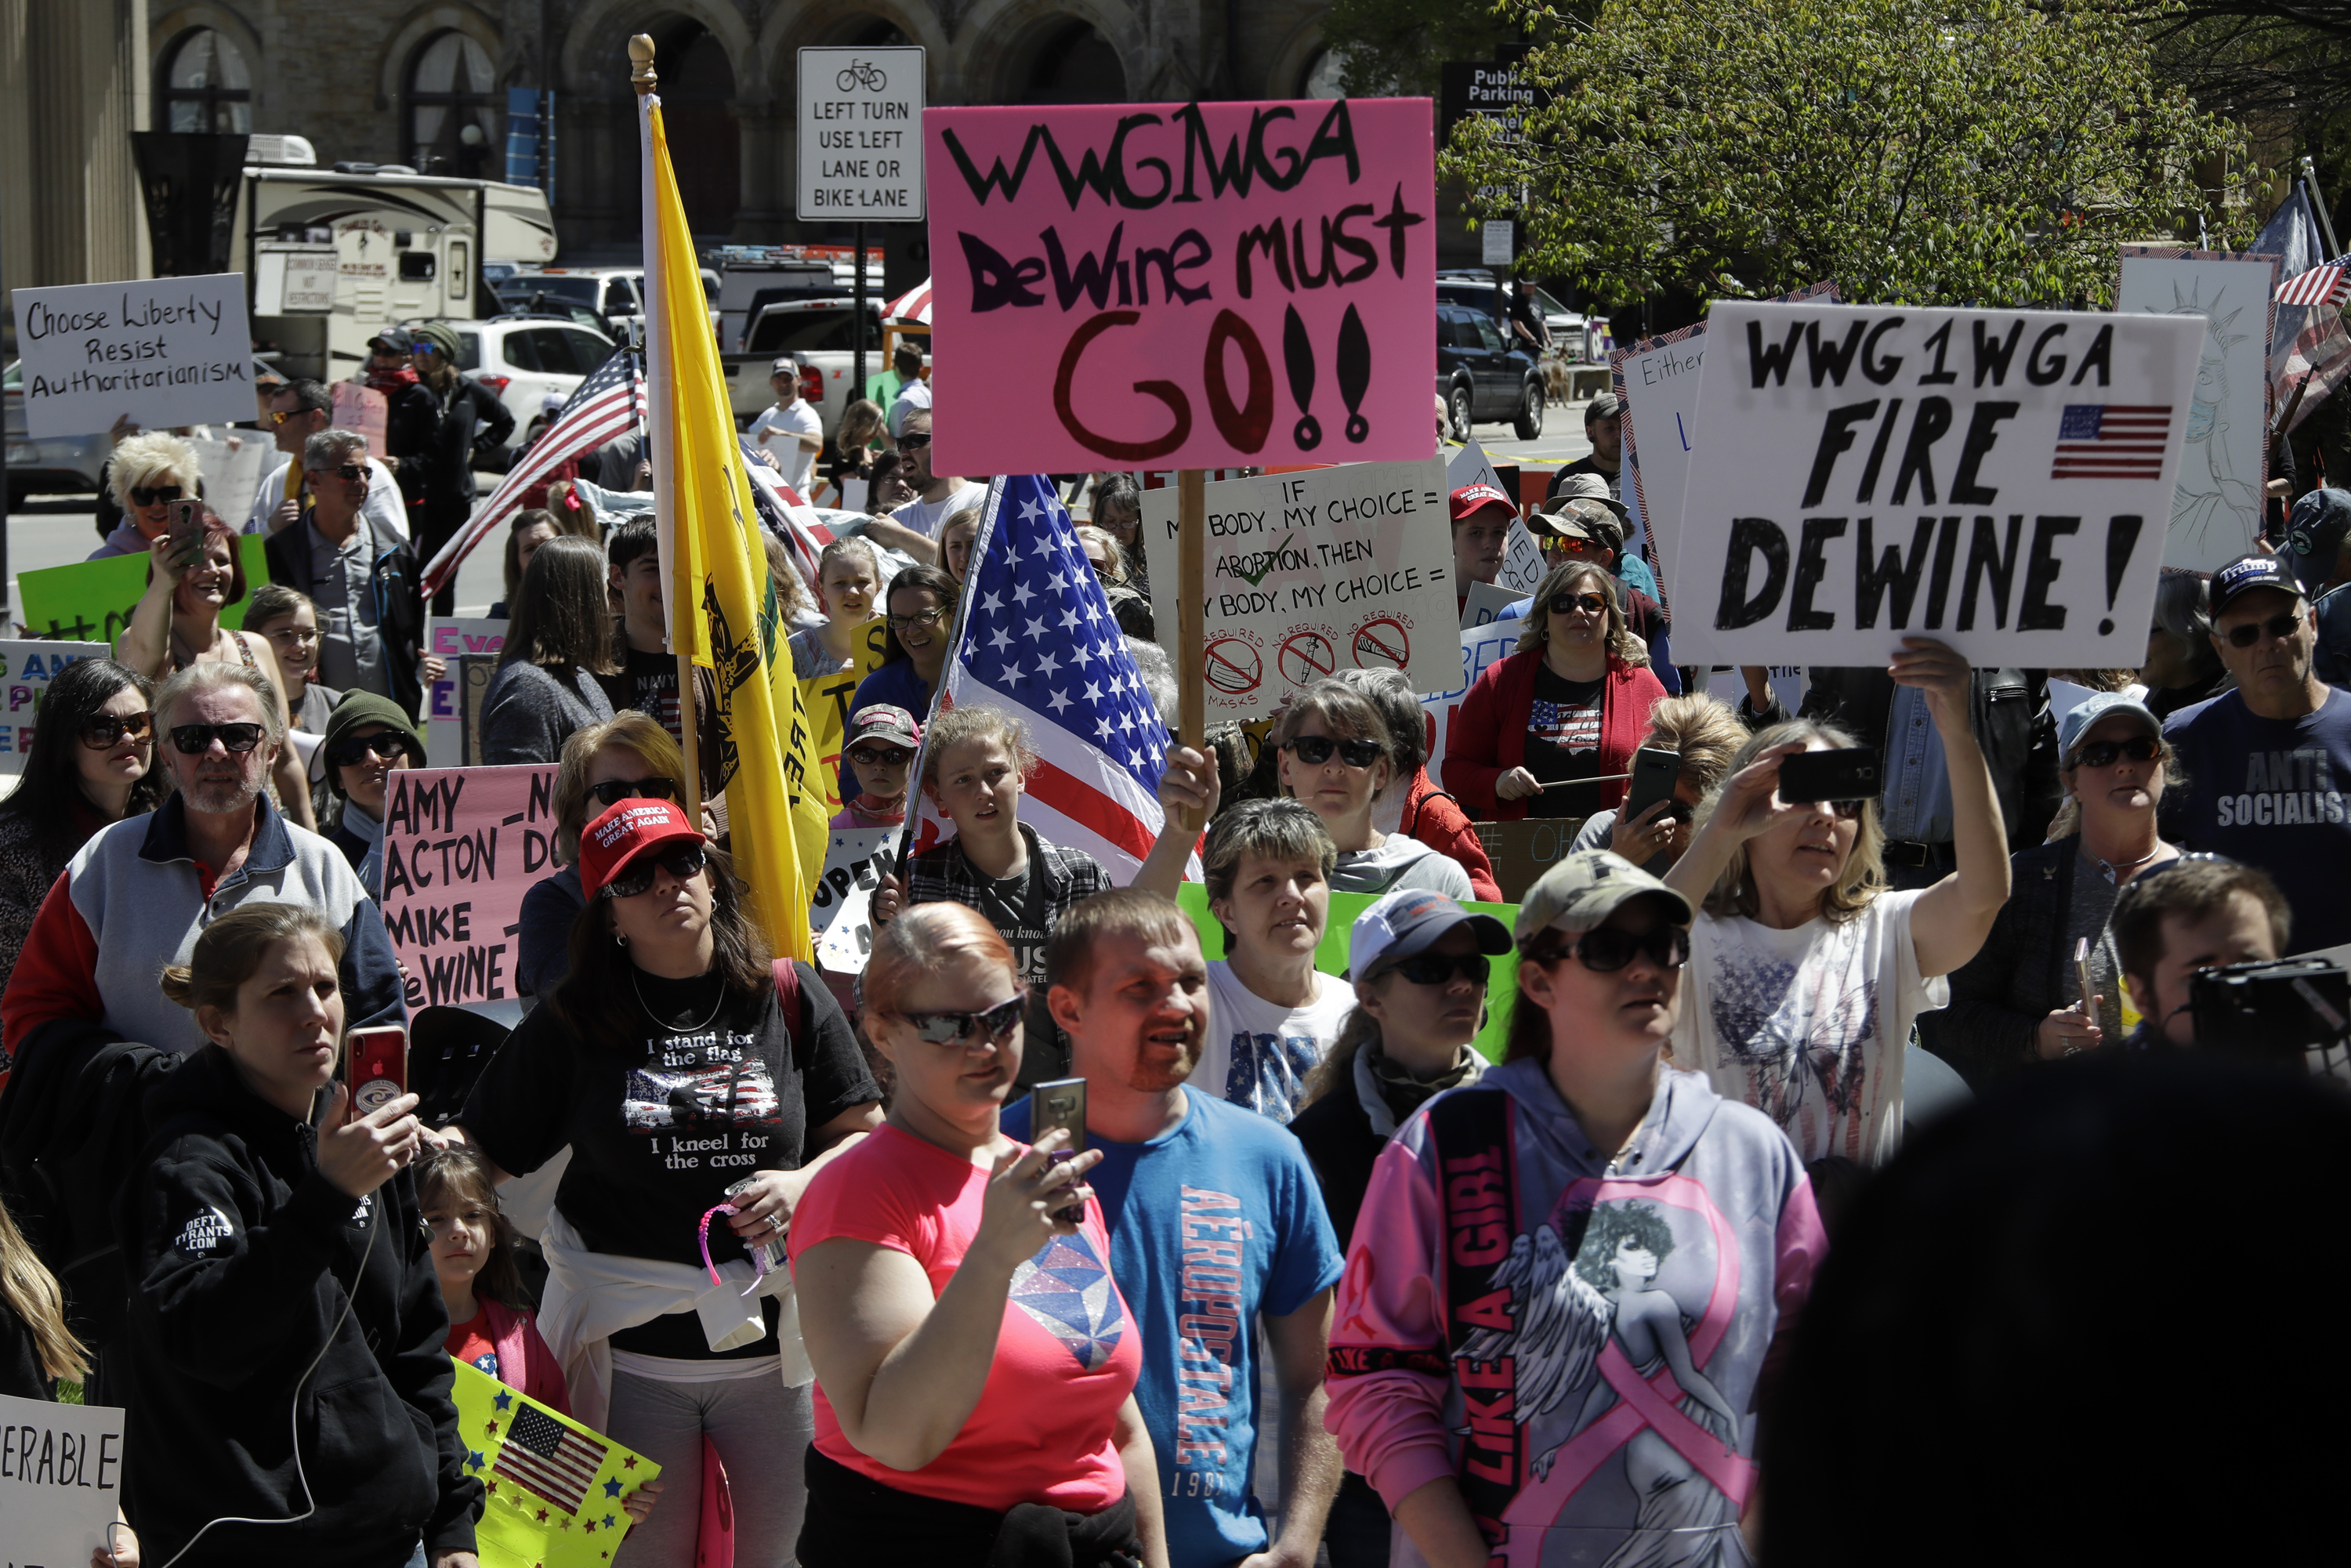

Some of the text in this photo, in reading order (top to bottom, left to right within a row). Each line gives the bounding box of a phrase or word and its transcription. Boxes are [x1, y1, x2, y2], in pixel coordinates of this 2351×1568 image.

[1475, 70, 1527, 85] Public
[1469, 85, 1534, 104] Parking
[814, 102, 908, 119] LEFT TURN
[820, 131, 903, 148] USE LEFT
[823, 160, 900, 177] LANE OR
[941, 100, 1360, 212] WWG1WGA
[814, 189, 907, 207] BIKE LANE
[27, 292, 222, 340] Choose Liberty
[85, 335, 168, 364] Resist
[1747, 316, 2113, 389] WWG1WGA
[1053, 302, 1371, 462] GO!!
[1641, 350, 1705, 386] Either
[1801, 395, 2020, 509] FIRE
[1282, 480, 1306, 504] IF
[1459, 486, 1480, 499] MAKE
[1284, 505, 1317, 531] MY
[1327, 488, 1418, 524] CHOICE
[2219, 559, 2278, 585] Trump
[1291, 583, 1327, 610] MY
[1335, 567, 1423, 603] CHOICE
[1271, 622, 1339, 650] NO REQUIRED
[1346, 610, 1415, 639] NO REQUIRED
[636, 674, 676, 690] NAVY
[1207, 694, 1259, 710] MASKS
[2244, 748, 2328, 792] ANTI
[385, 773, 465, 836] AMY
[594, 806, 671, 841] MAKE AMERICA
[602, 815, 672, 849] GREAT AGAIN
[382, 827, 498, 901] ACTON
[385, 901, 472, 949] MIKE
[395, 943, 506, 1009] eWINE
[647, 1030, 755, 1055] I stand for
[662, 1045, 743, 1067] the flag
[650, 1132, 770, 1153] I kneel for
[665, 1153, 756, 1169] the cross
[175, 1226, 232, 1246] TYRANTS
[185, 1215, 217, 1232] DEFY
[185, 1237, 217, 1251] .COM
[1446, 1144, 1516, 1489] LIKE A GIRL
[0, 1425, 120, 1490] ERABLE
